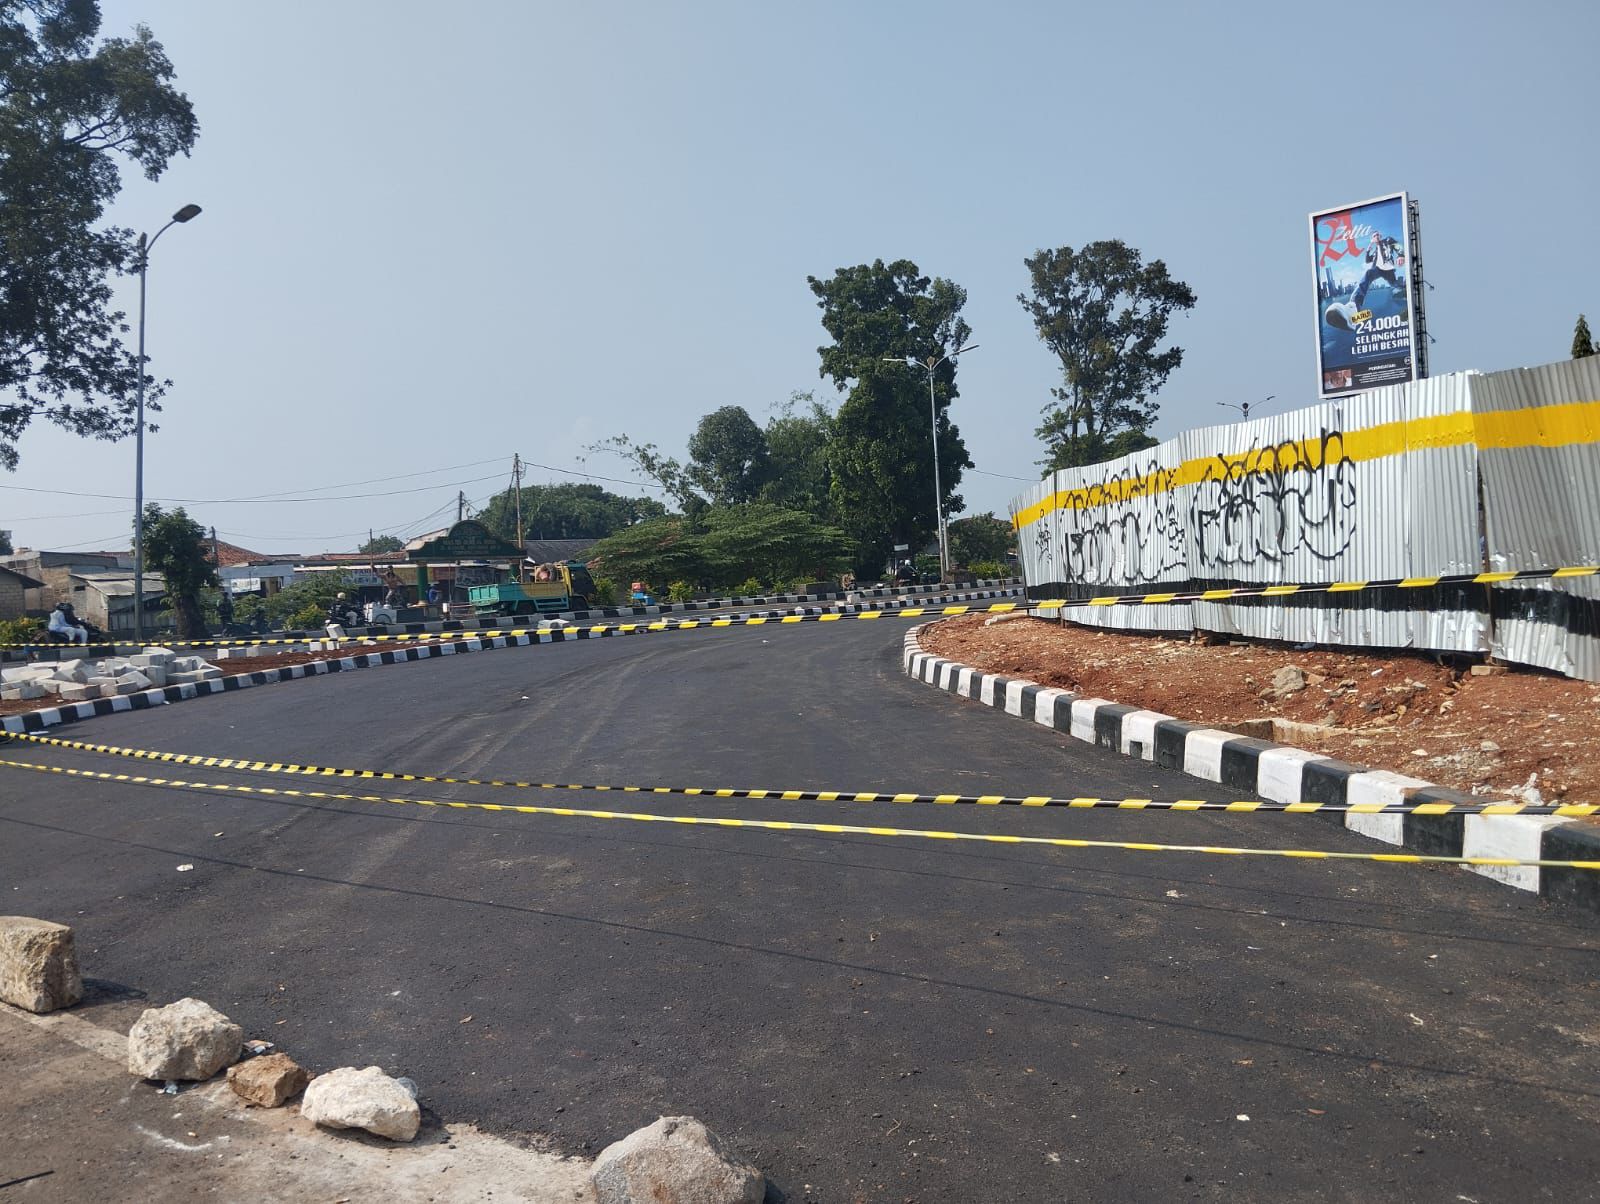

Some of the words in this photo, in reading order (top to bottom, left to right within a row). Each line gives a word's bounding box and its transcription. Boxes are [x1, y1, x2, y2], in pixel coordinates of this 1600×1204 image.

[1355, 328, 1409, 345] SELANGKAH
[1351, 342, 1378, 355] LEBIH
[1380, 337, 1410, 351] BESAR
